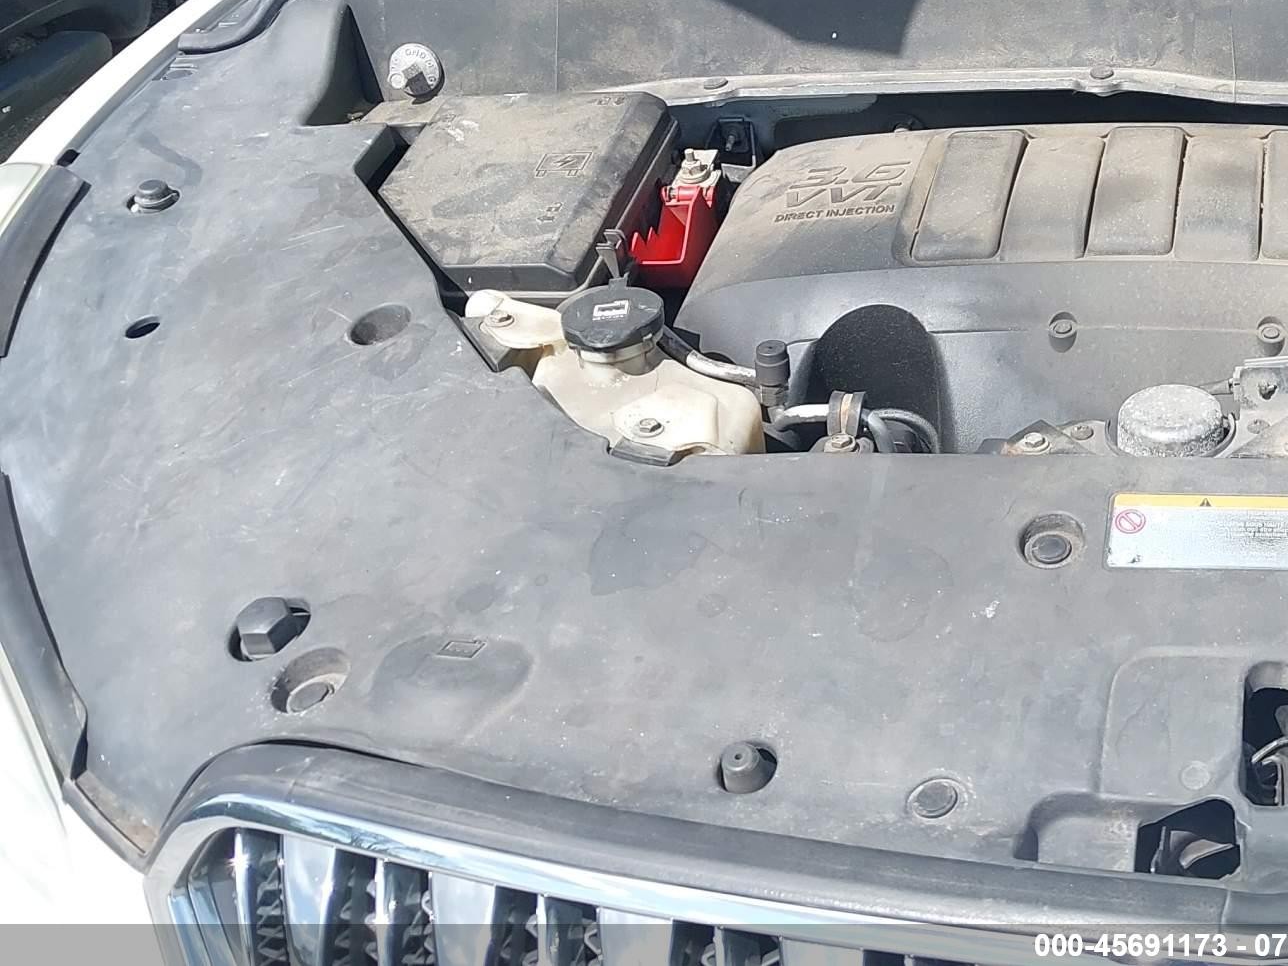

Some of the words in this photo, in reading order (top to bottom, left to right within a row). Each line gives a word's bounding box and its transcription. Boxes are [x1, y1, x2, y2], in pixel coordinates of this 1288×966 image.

[790, 161, 911, 188] 3.6
[786, 182, 902, 208] VVT
[774, 209, 824, 223] DIRECT
[826, 204, 896, 218] INJECTION
